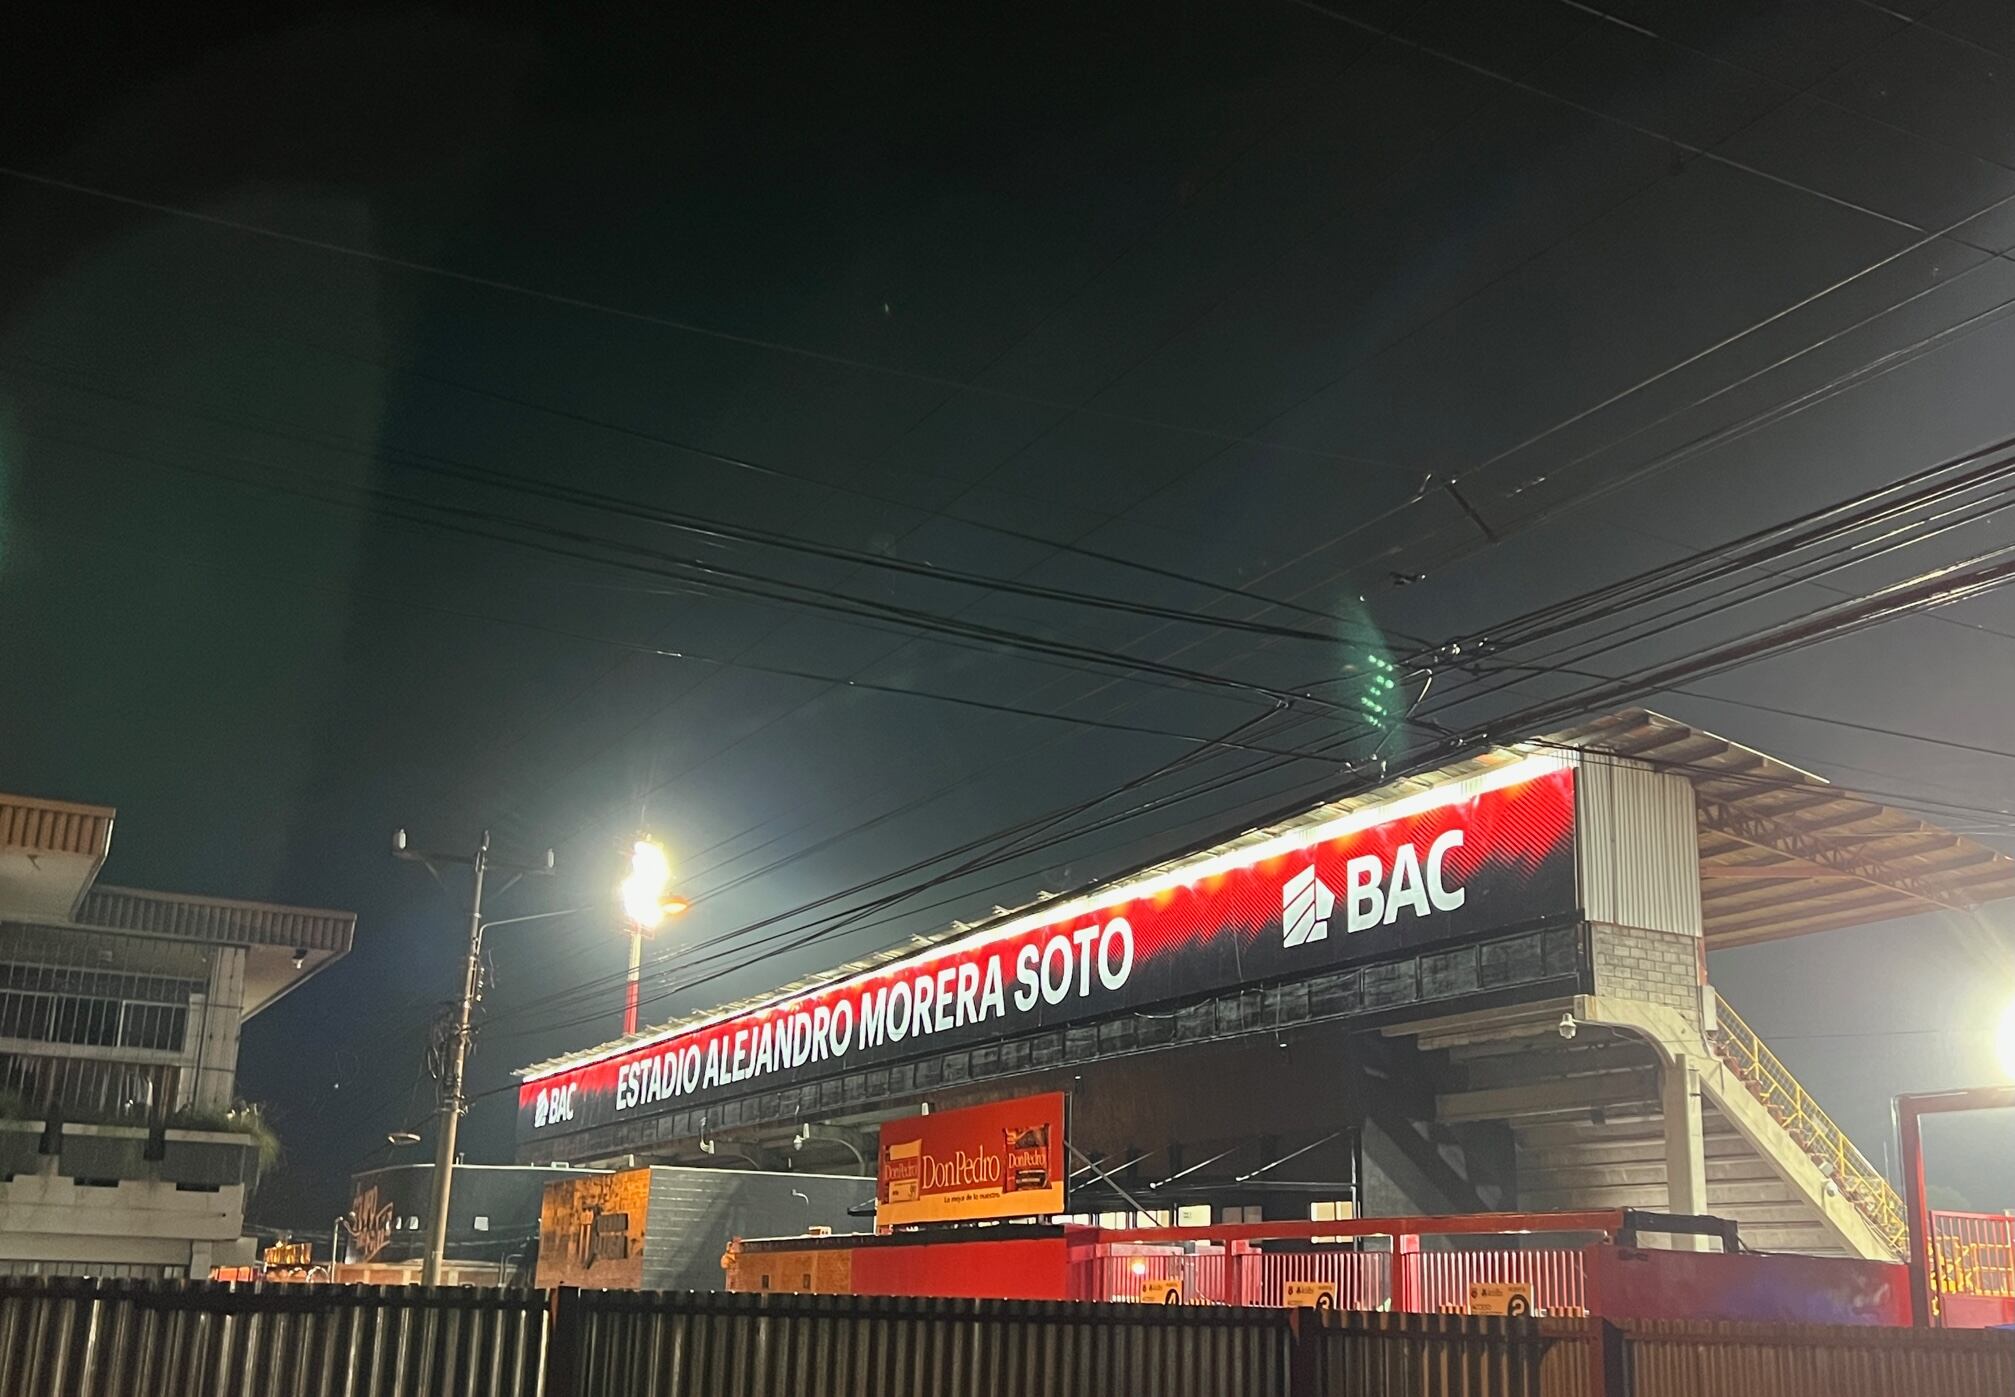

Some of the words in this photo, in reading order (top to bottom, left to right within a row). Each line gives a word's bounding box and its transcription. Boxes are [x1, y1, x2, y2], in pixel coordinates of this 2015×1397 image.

[1347, 829, 1465, 933] BAC
[615, 1044, 701, 1111] ESTADIO
[702, 998, 853, 1090] ALEJANDRO
[858, 955, 1005, 1050] MORERA
[1014, 917, 1134, 1012] SOTO
[548, 1082, 577, 1124] BAC
[922, 1144, 1000, 1190] DonPedro
